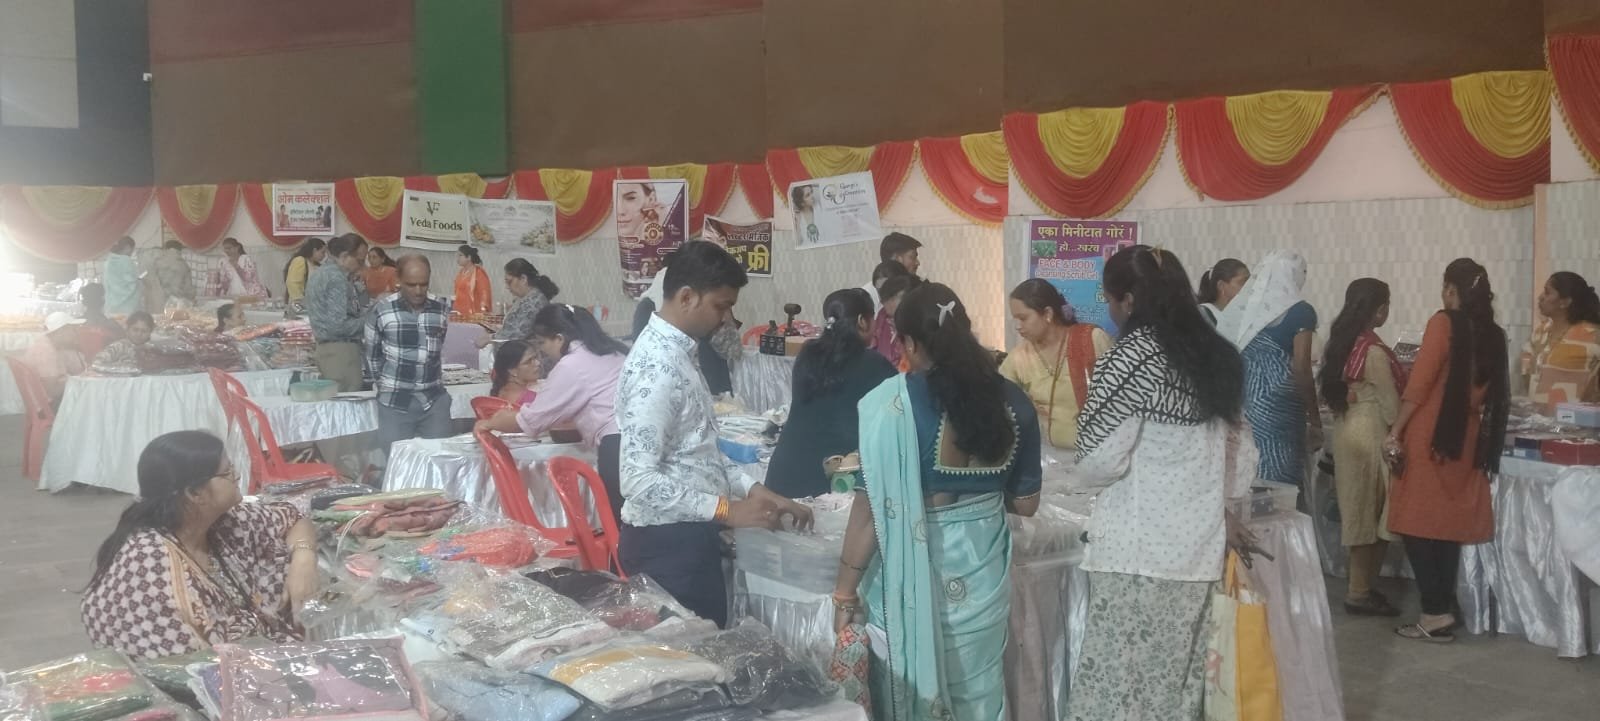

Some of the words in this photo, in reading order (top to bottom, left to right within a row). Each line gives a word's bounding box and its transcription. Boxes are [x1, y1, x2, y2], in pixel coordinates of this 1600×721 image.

[410, 216, 431, 228] Veda
[433, 219, 463, 231] Foods
[1038, 227, 1058, 239] एका
[1062, 223, 1102, 238] मिनीटात
[1106, 224, 1125, 238] गोरं
[1038, 258, 1061, 269] FACE
[1063, 259, 1071, 270] &
[1071, 259, 1096, 271] BODY
